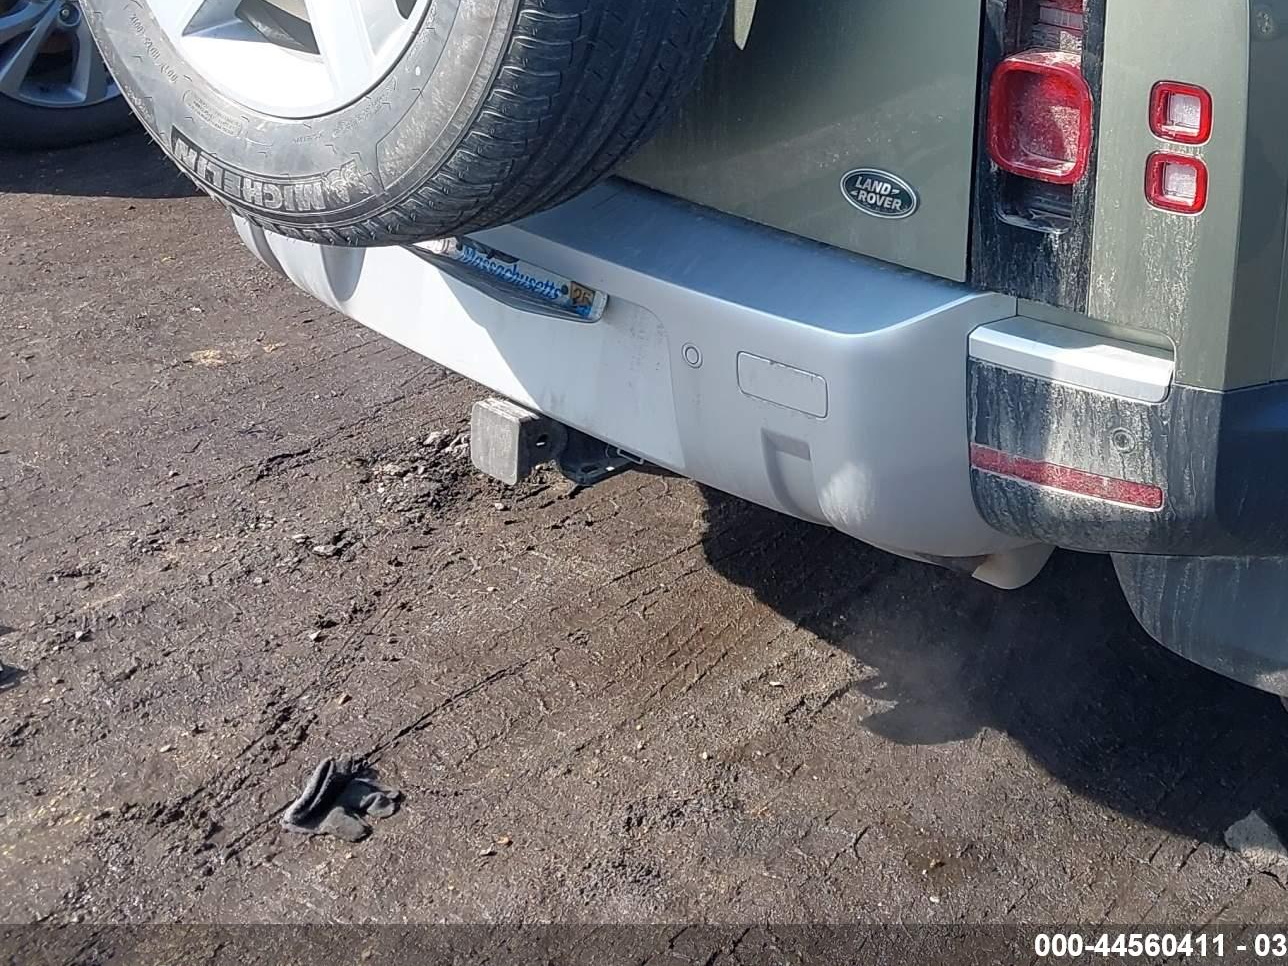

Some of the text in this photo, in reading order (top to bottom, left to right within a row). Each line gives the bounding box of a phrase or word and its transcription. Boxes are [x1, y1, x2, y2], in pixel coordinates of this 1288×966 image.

[174, 137, 327, 211] MICHELIN
[855, 176, 891, 195] LAND
[857, 190, 902, 211] ROVER
